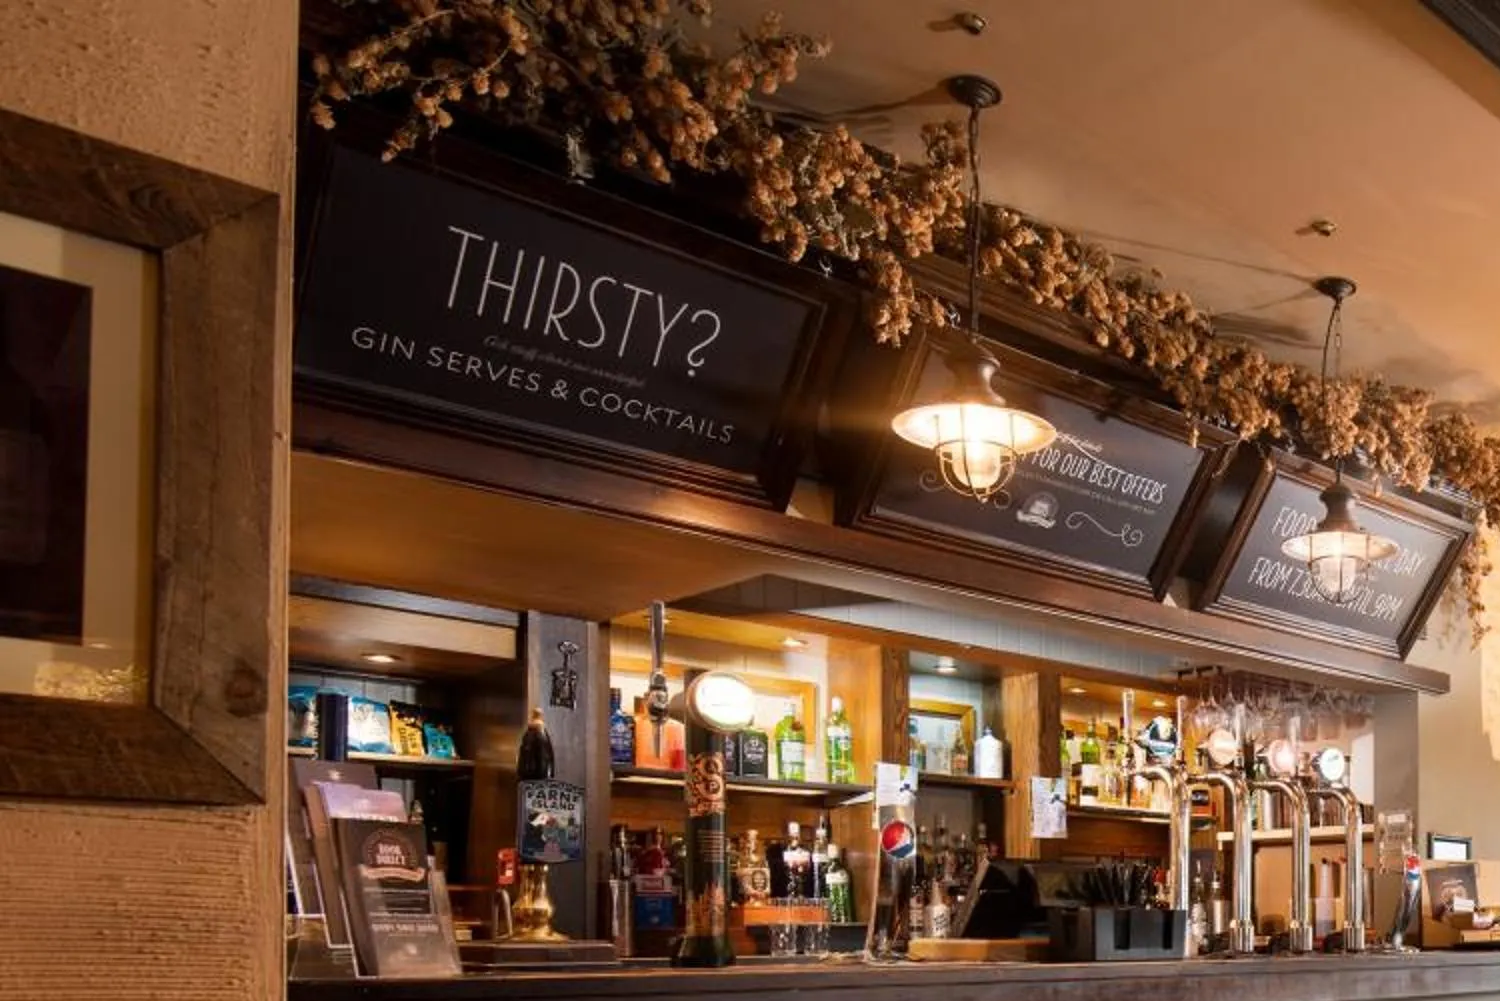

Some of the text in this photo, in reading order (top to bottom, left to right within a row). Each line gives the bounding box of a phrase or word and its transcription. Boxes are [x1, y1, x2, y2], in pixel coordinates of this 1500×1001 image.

[448, 225, 721, 377] THIRSTY?
[351, 326, 416, 361] GIN
[426, 346, 541, 392] SERVES
[550, 378, 570, 400] &
[579, 387, 735, 444] COCKTAILS
[1060, 453, 1090, 480] OUR
[1088, 461, 1126, 491] BEST
[1121, 473, 1168, 504] OFFERS
[1247, 557, 1293, 592] FROM
